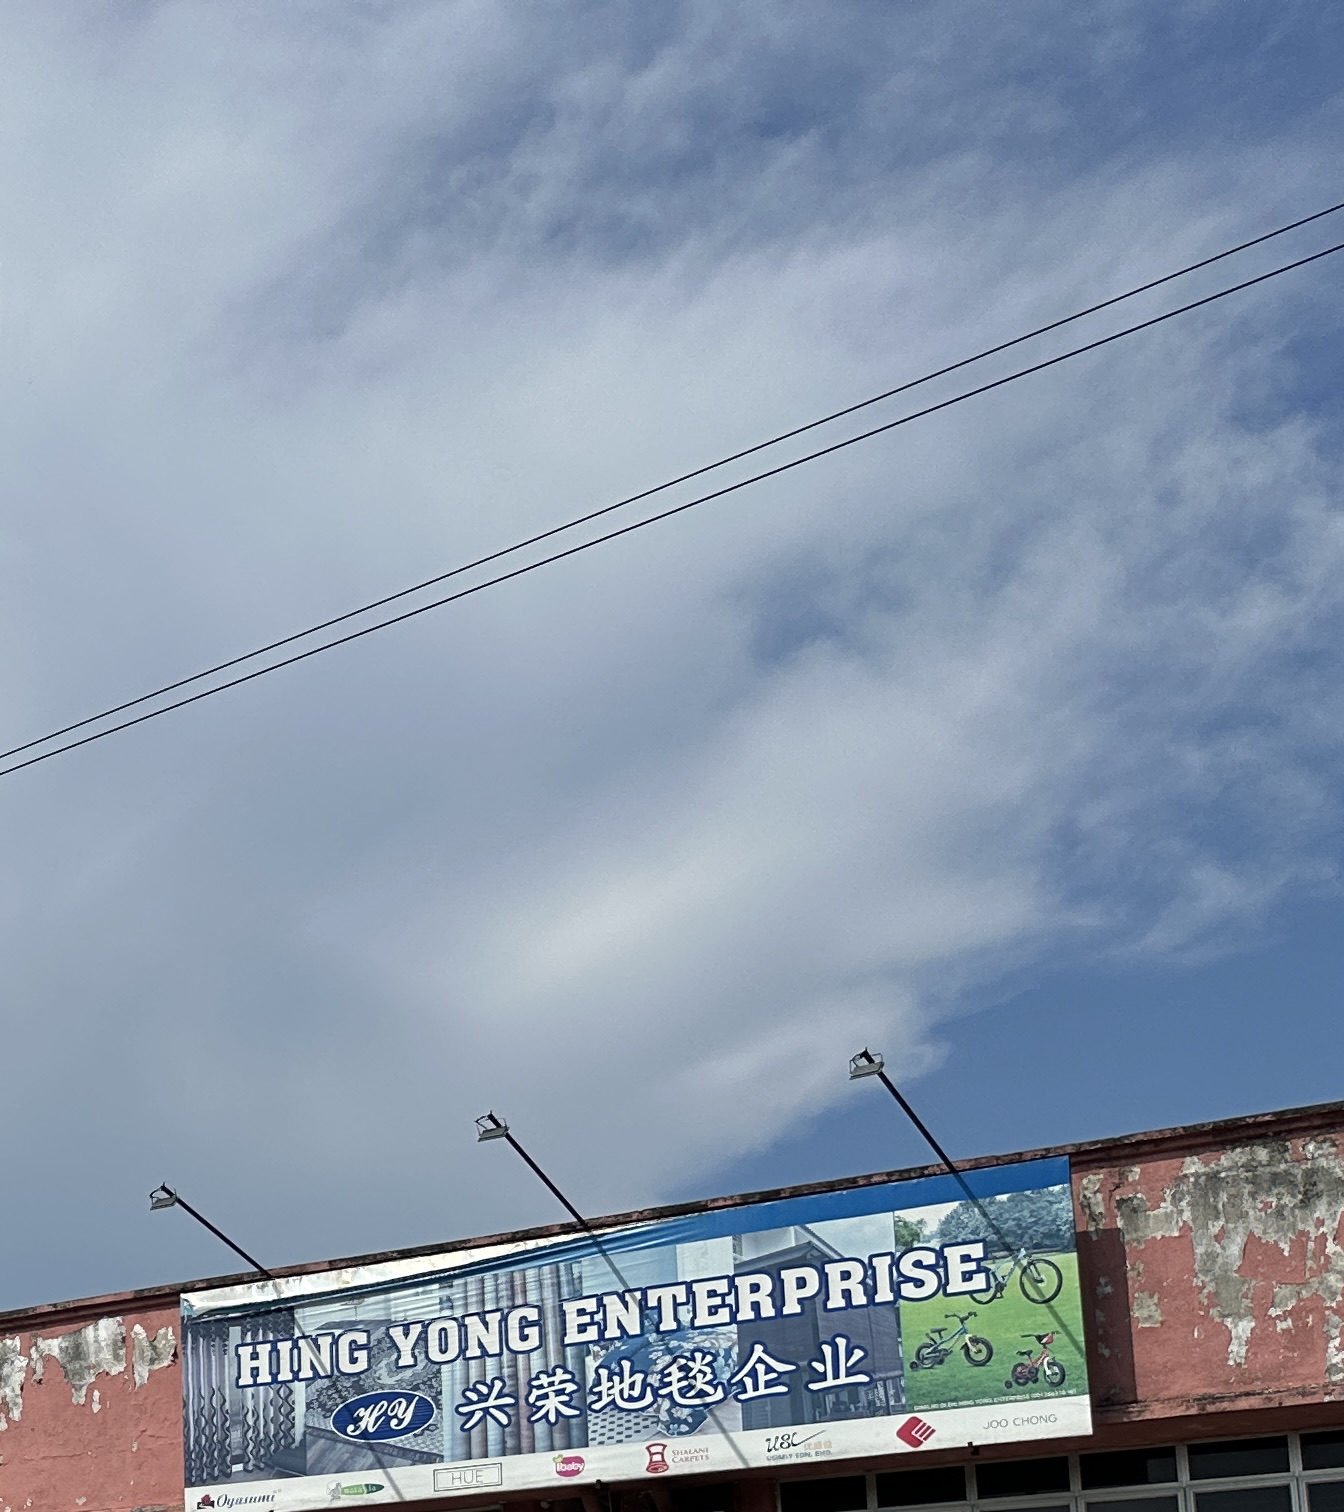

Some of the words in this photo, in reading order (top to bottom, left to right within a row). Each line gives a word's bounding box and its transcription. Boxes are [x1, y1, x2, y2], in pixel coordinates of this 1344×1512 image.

[236, 1329, 371, 1388] HING
[387, 1304, 543, 1369] YONG
[561, 1239, 991, 1347] ENTERPRISE
[456, 1334, 872, 1431] 兴荣地毯企业
[983, 1418, 1009, 1430] JOO
[1013, 1413, 1058, 1427] CHONG
[451, 1469, 484, 1485] HUE
[217, 1493, 275, 1508] Oyasumi
